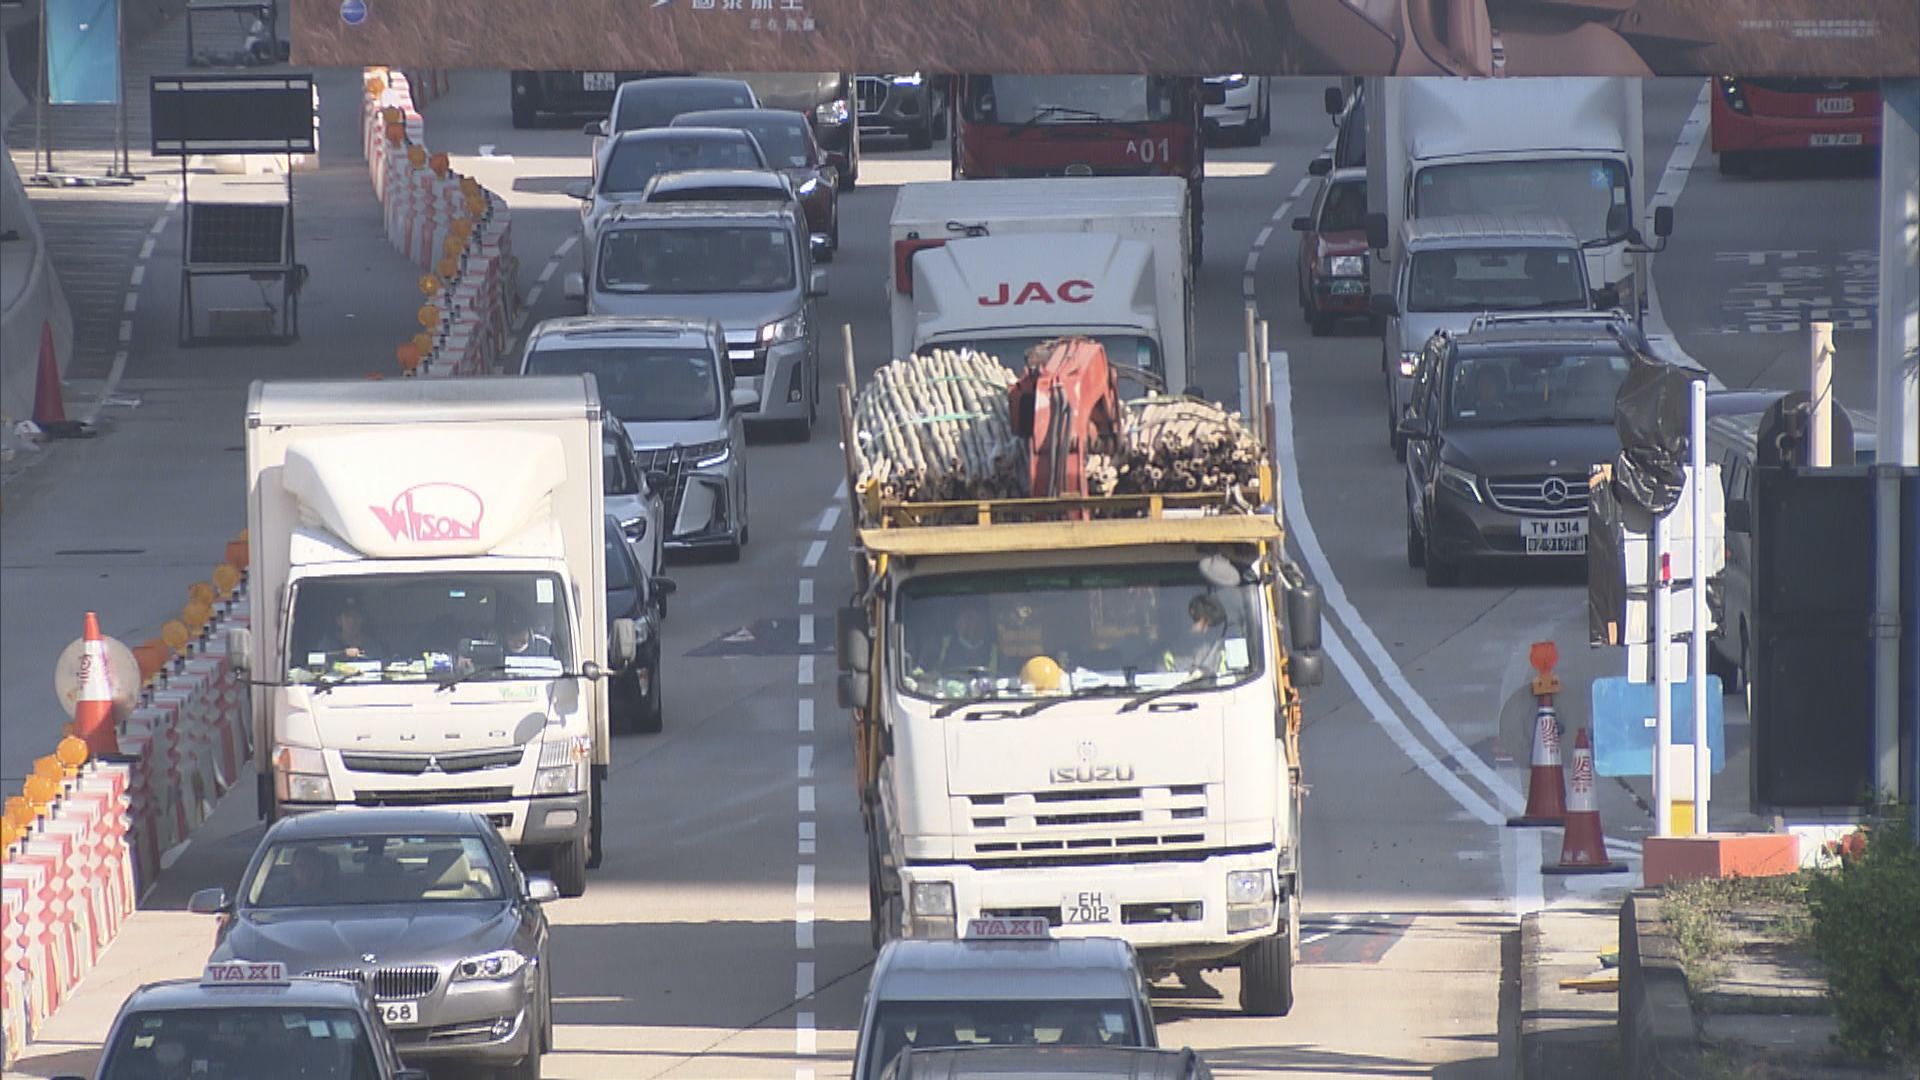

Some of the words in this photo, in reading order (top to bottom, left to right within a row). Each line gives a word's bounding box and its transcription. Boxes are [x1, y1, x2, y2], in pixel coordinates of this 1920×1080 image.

[1816, 97, 1854, 113] KMB
[978, 280, 1095, 305] JAC
[1531, 521, 1549, 534] TW
[1554, 521, 1580, 534] 1314
[1049, 764, 1135, 784] ISUZU
[1078, 892, 1102, 907] EH
[1068, 906, 1110, 922] 7012
[972, 920, 1044, 935] TAXI
[208, 964, 280, 981] TAXI
